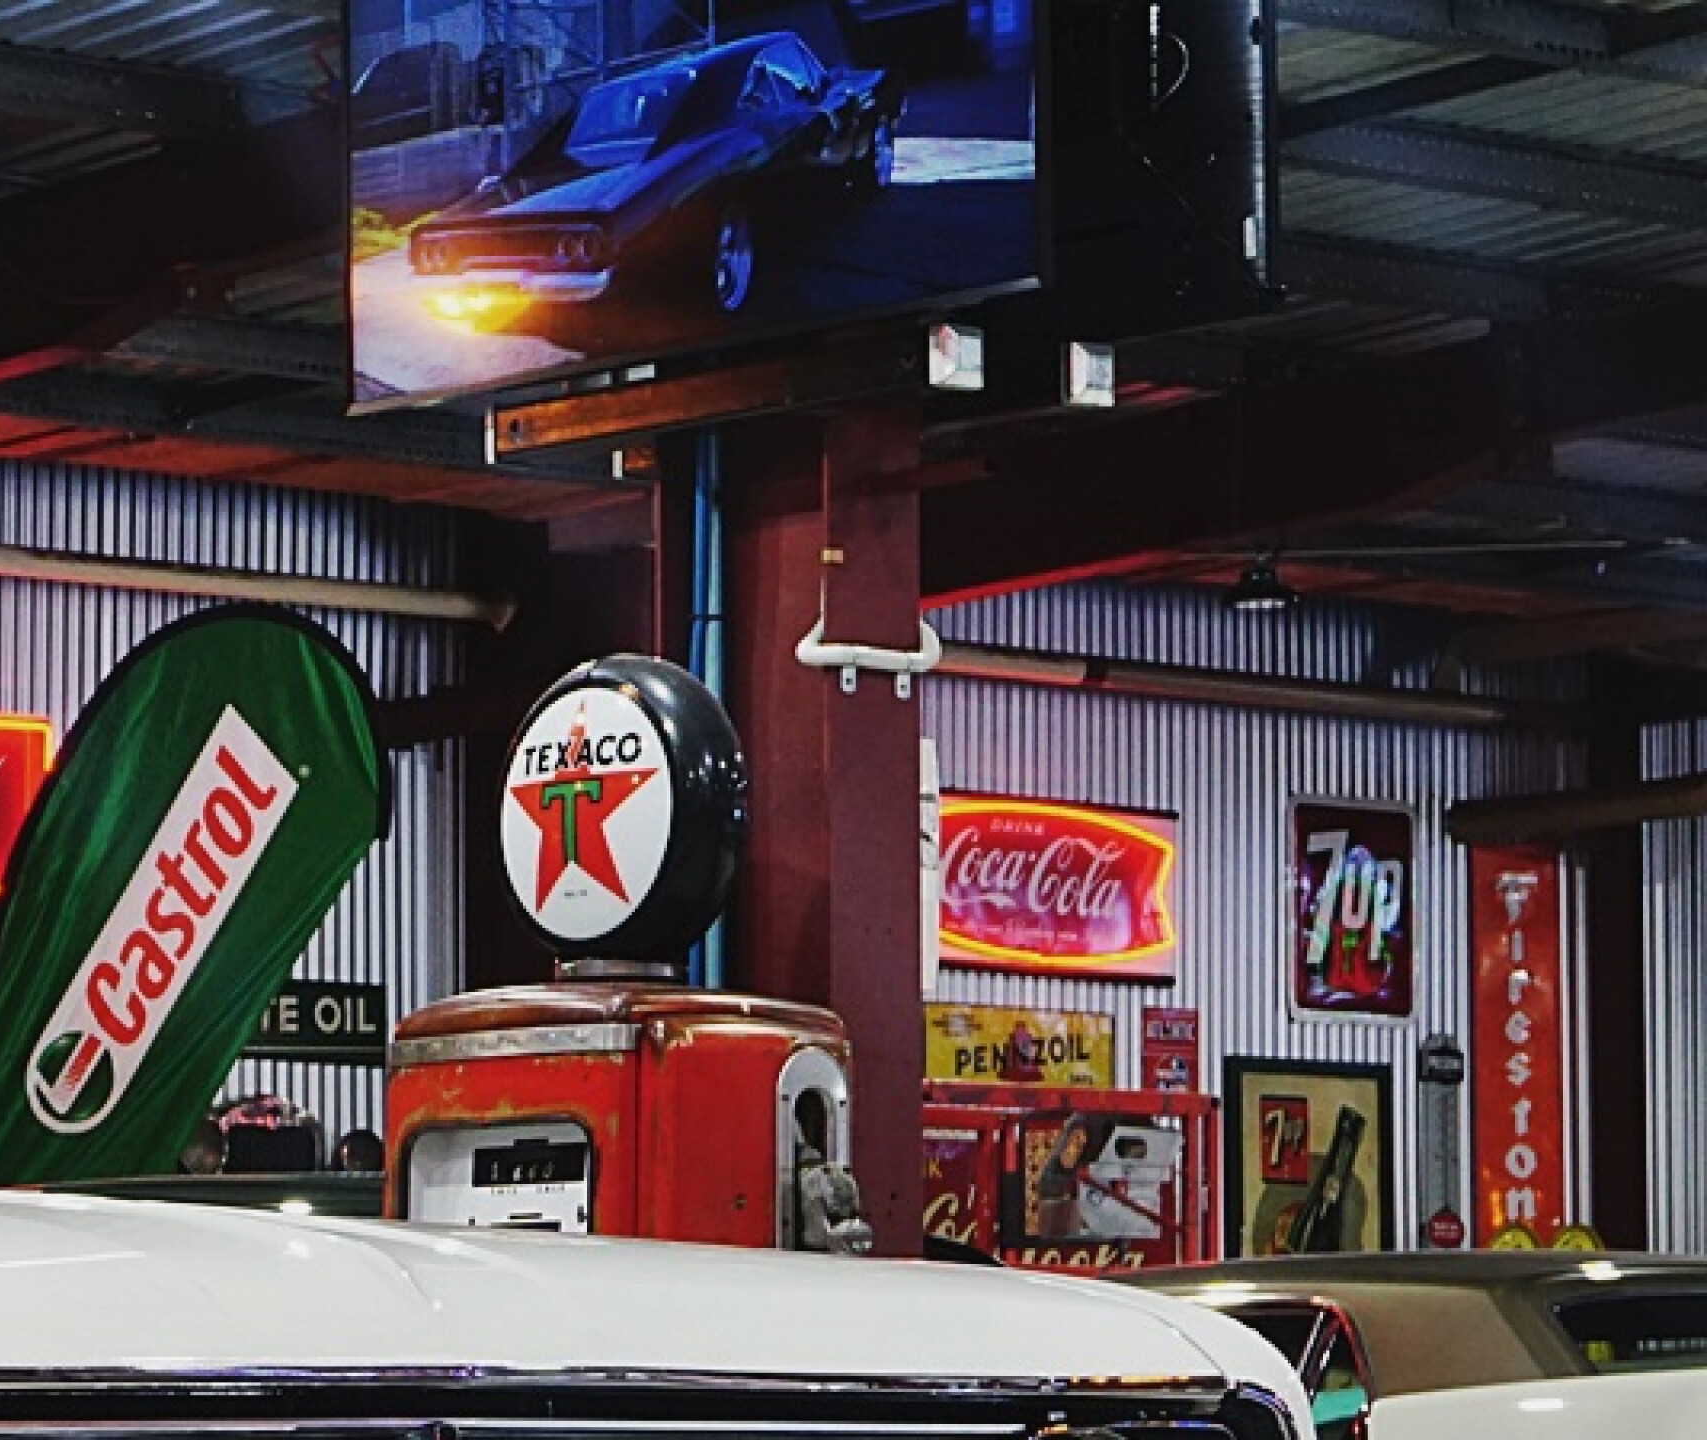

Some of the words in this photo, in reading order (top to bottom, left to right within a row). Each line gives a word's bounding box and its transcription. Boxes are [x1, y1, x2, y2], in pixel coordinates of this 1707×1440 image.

[523, 732, 642, 776] TEXACO
[540, 777, 602, 864] T
[86, 744, 279, 1047] Castrol
[939, 823, 1126, 919] Coca-Cola
[313, 994, 377, 1033] OIL
